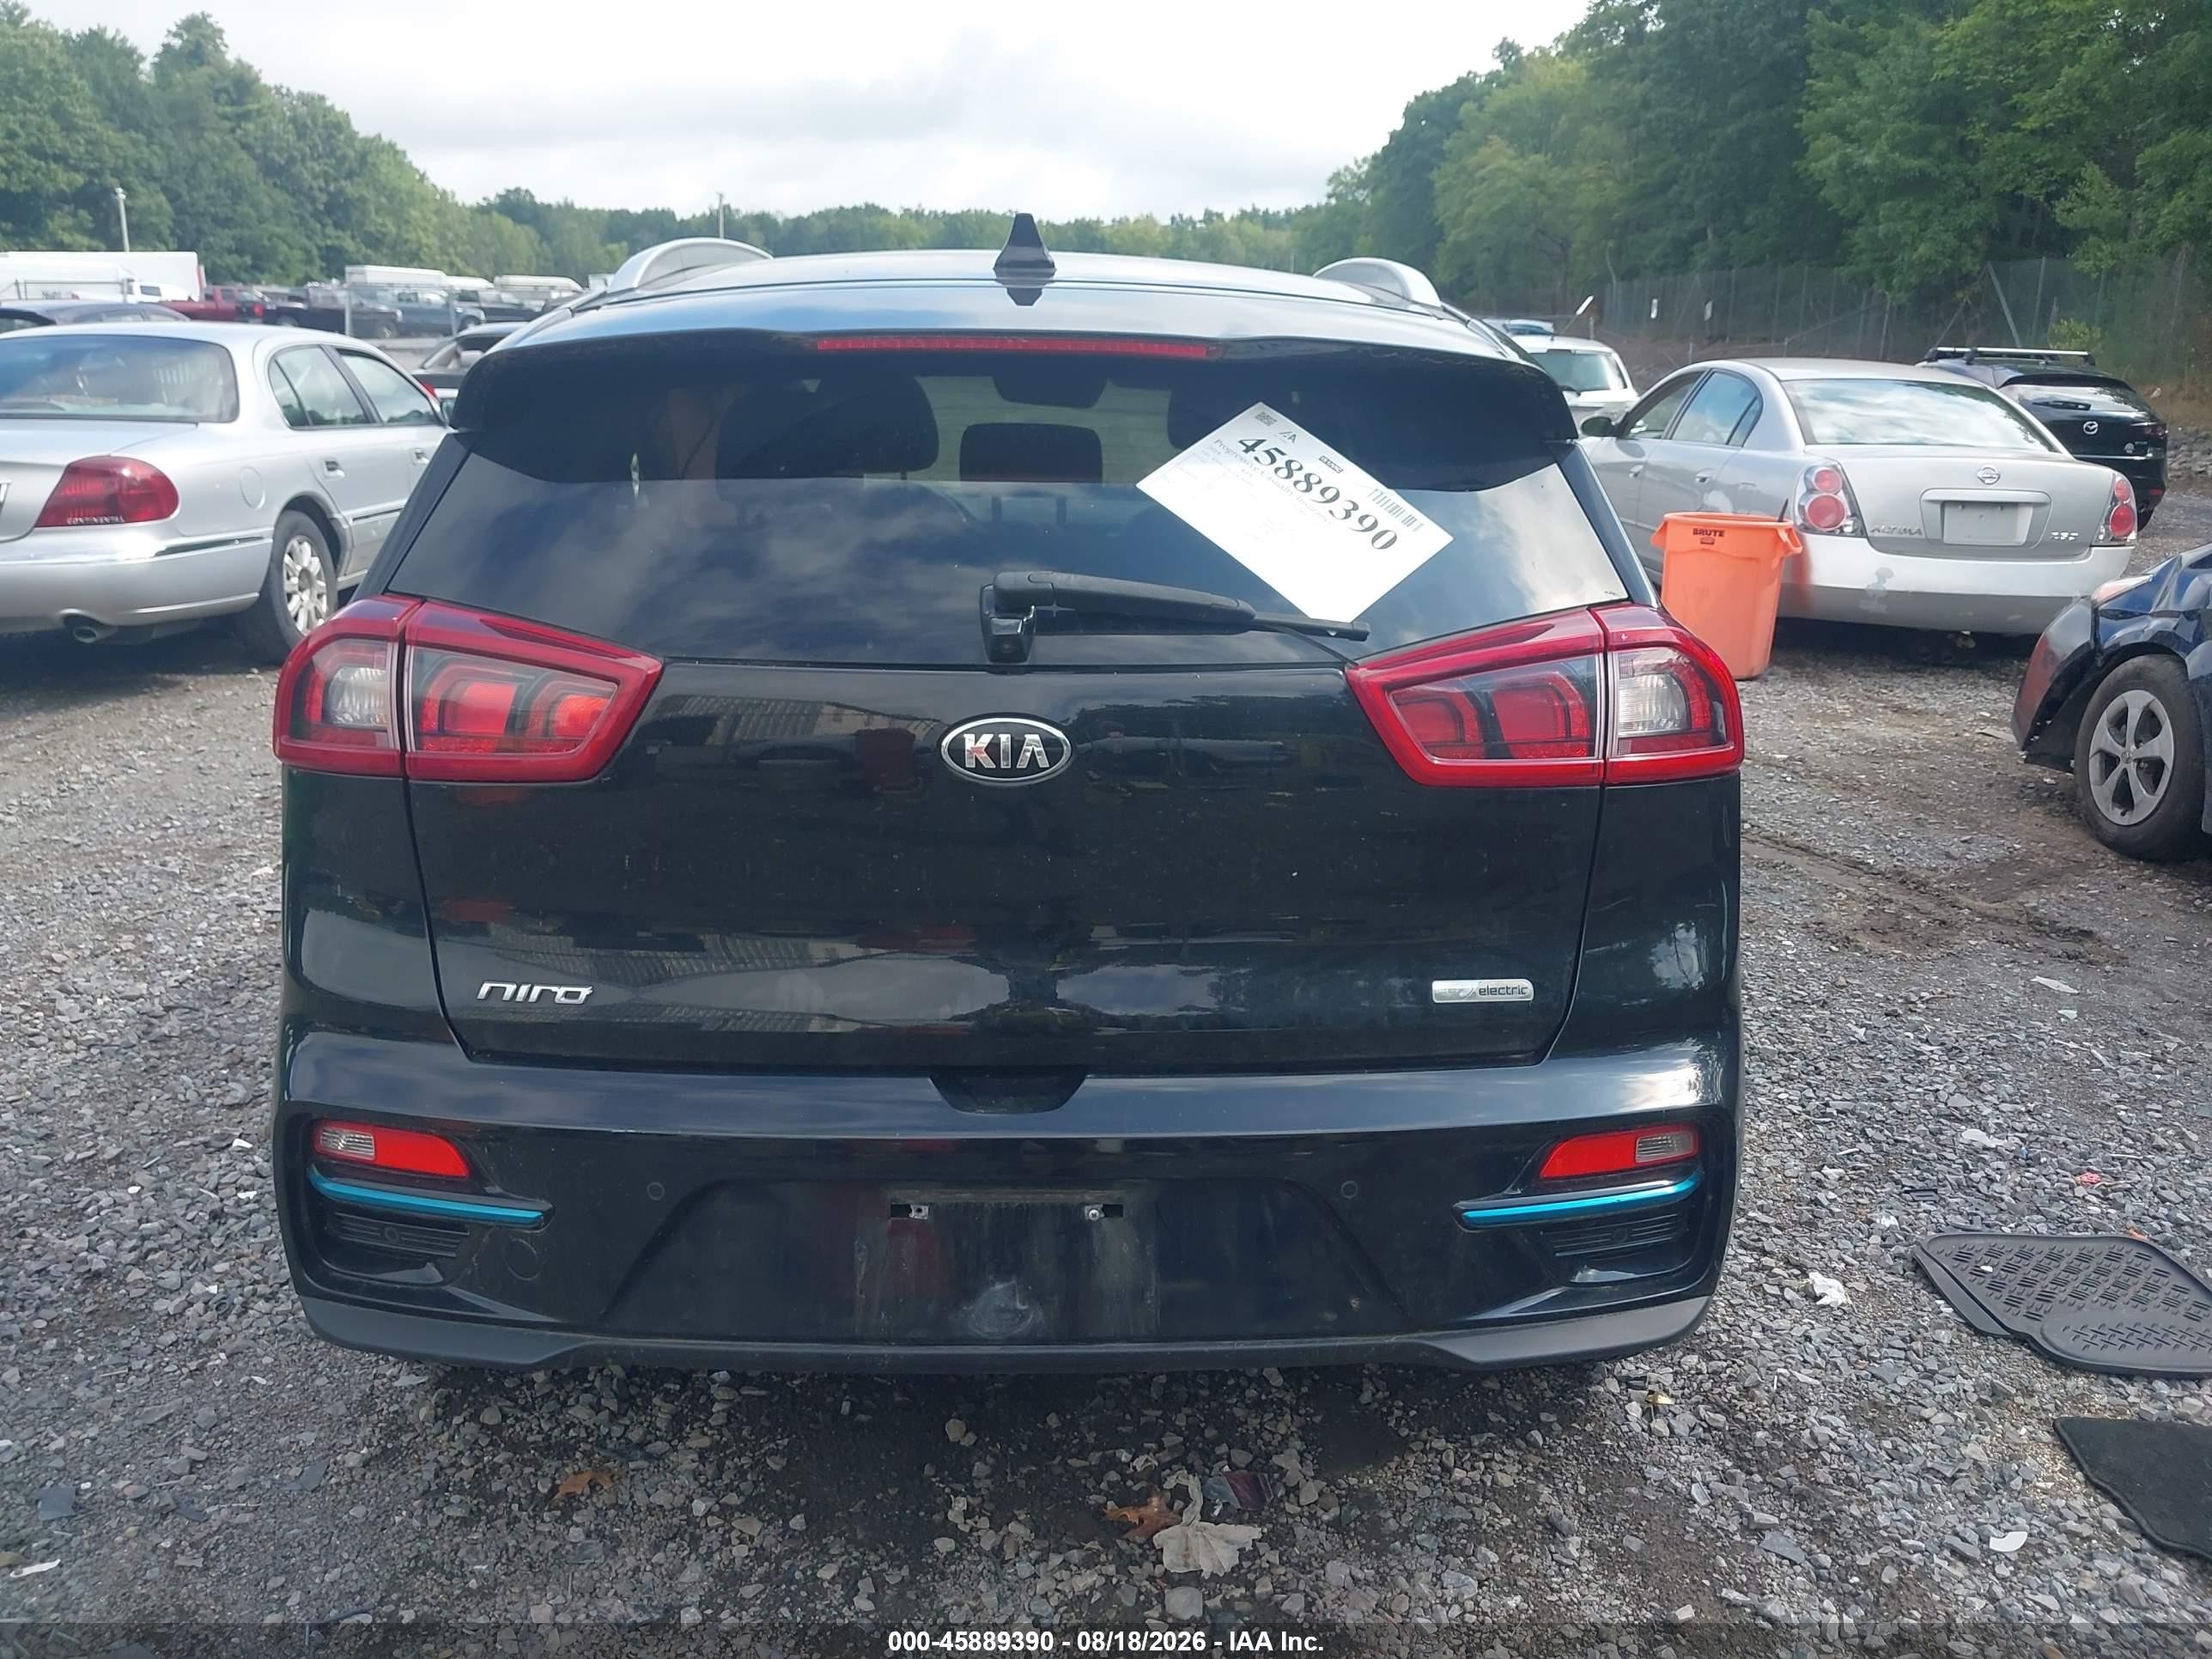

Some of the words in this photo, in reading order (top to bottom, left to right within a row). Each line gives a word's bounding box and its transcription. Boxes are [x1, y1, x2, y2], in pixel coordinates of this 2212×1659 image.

[1212, 439, 1260, 472] Progressive
[1237, 436, 1398, 550] 45889390
[1692, 528, 1725, 538] BRUTE
[963, 733, 1049, 769] KIA
[1478, 985, 1528, 996] electric
